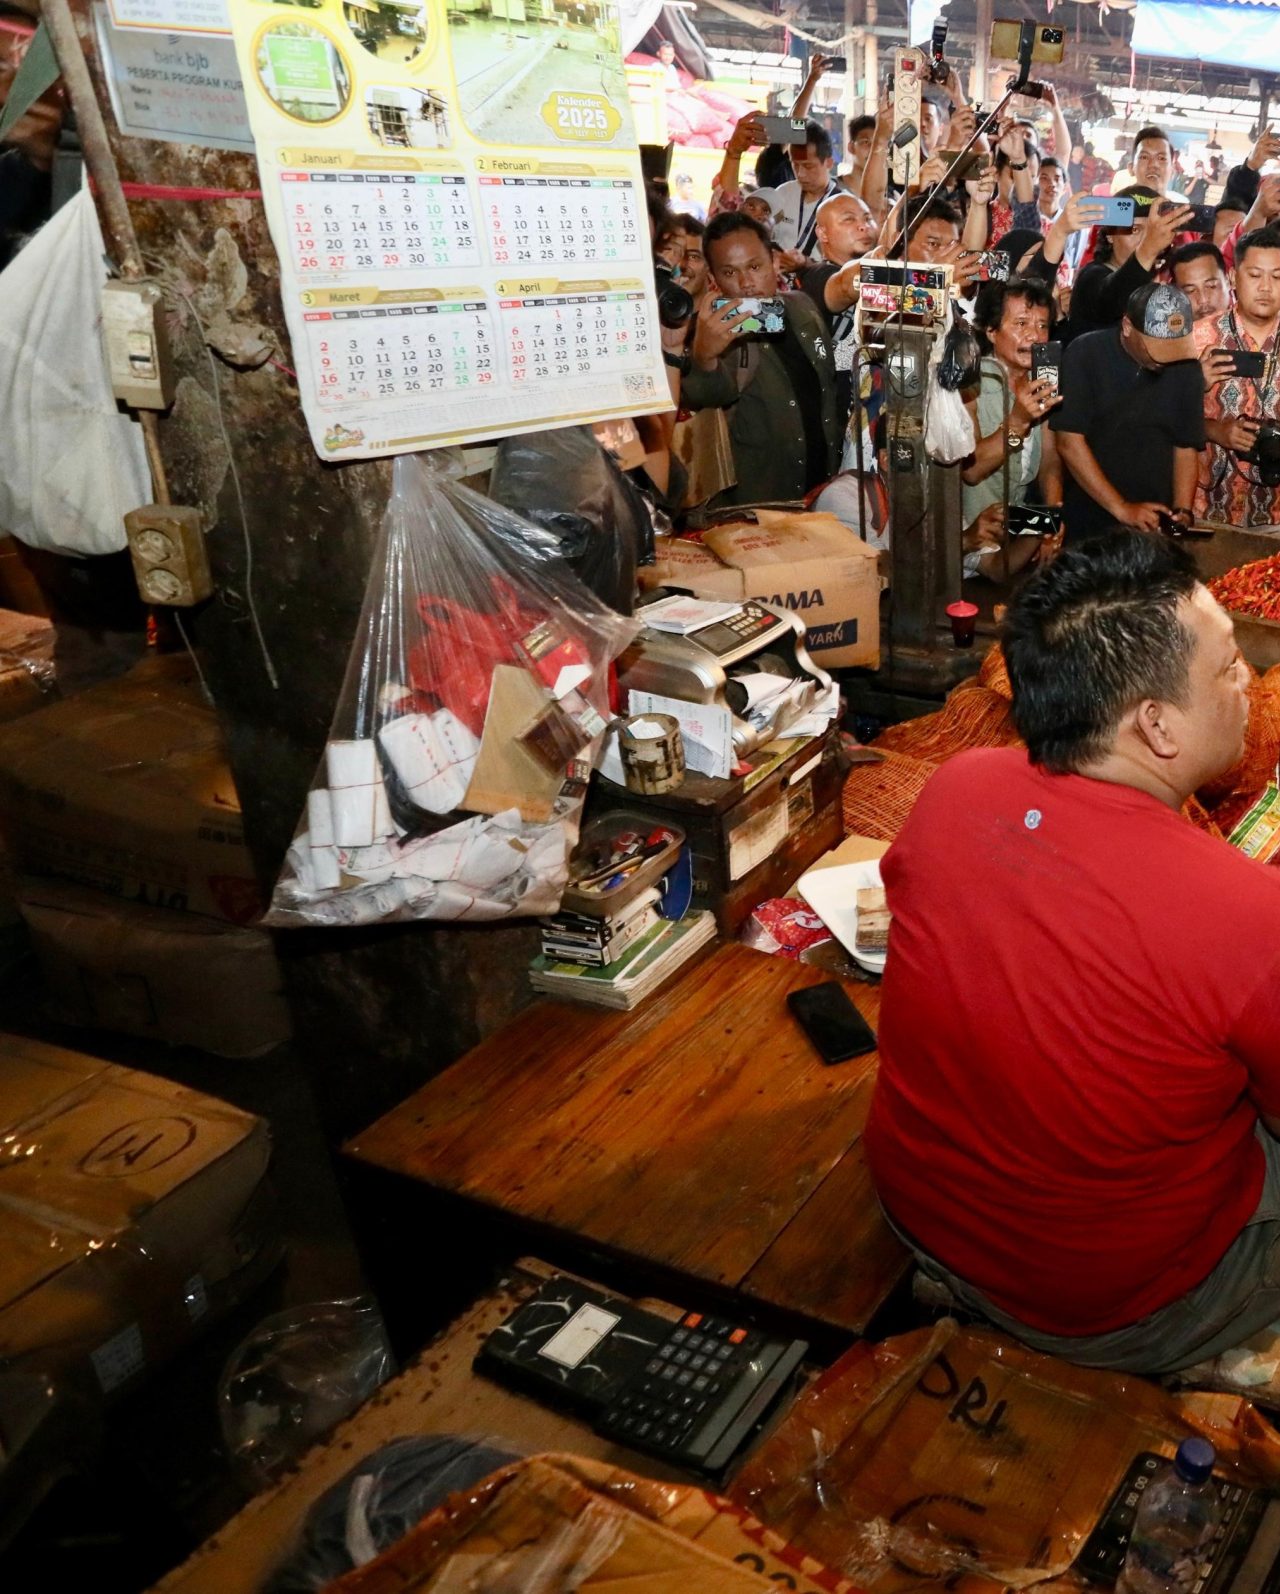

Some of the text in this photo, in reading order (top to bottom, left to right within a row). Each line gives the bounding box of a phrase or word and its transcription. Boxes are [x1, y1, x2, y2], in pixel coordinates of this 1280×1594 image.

[153, 48, 210, 72] bank bjb
[126, 66, 170, 83] PESERTA
[172, 73, 221, 89] PROGRAM
[557, 106, 608, 129] 2025
[281, 152, 287, 162] 1
[301, 153, 342, 165] Januari
[478, 159, 532, 171] 2 Februari
[376, 188, 384, 198] 1
[402, 188, 410, 198] 2
[451, 189, 459, 198] 4
[621, 192, 627, 200] 1
[296, 204, 305, 215] 5
[324, 204, 333, 215] 6
[351, 204, 360, 215] 7
[379, 204, 387, 215] 8
[404, 204, 412, 215] 9
[452, 205, 466, 215] 11
[491, 205, 629, 215] 2 3 4 5 6 8
[295, 222, 312, 233] 12
[324, 221, 340, 232] 13
[352, 221, 367, 232] 14
[378, 221, 393, 232] 15
[404, 221, 419, 231] 16
[455, 221, 469, 231] 18
[493, 220, 634, 230] 9 10 11 12 13 15
[298, 239, 315, 250] 19
[326, 238, 343, 249] 20
[354, 238, 369, 249] 21
[381, 238, 396, 249] 22
[406, 237, 422, 248] 23
[457, 236, 472, 246] 25
[493, 236, 507, 246] 16
[516, 235, 529, 245] 17
[539, 235, 552, 245] 18
[562, 235, 574, 244] 19
[583, 234, 596, 243] 20
[624, 234, 637, 243] 22
[301, 256, 318, 267] 26
[328, 256, 345, 267] 27
[356, 255, 373, 265] 28
[383, 254, 399, 265] 29
[409, 253, 425, 264] 30
[495, 251, 509, 261] 23
[518, 250, 531, 260] 24
[540, 250, 554, 259] 25
[563, 249, 576, 259] 26
[584, 249, 596, 258] 27
[498, 282, 542, 294] 4 April
[303, 292, 360, 305] 3 Maret
[555, 303, 641, 318] 1 2 3 5
[476, 315, 482, 324] 1
[511, 317, 645, 336] 6 7 8 9 10 12
[319, 329, 485, 352] 2 3 4 5 6 8
[511, 330, 647, 350] 13 14 15 16 17 18 19
[321, 358, 331, 368] 9
[348, 355, 364, 366] 10
[376, 353, 390, 363] 11
[401, 351, 417, 361] 12
[427, 349, 442, 359] 13
[476, 345, 490, 354] 15
[511, 355, 526, 365] 20
[533, 353, 547, 362] 21
[555, 350, 568, 360] 22
[575, 349, 589, 358] 23
[596, 347, 608, 356] 24
[635, 343, 647, 352] 26
[321, 374, 338, 384] 16
[350, 371, 365, 381] 17
[377, 368, 393, 379] 18
[403, 366, 418, 376] 19
[427, 363, 443, 374] 20
[476, 359, 491, 368] 22
[513, 362, 591, 378] 27 28 29 30
[378, 384, 395, 394] 25
[404, 381, 421, 391] 26
[429, 378, 444, 388] 27
[477, 372, 492, 382] 29
[750, 588, 825, 611] AMA
[808, 628, 844, 647] YARN
